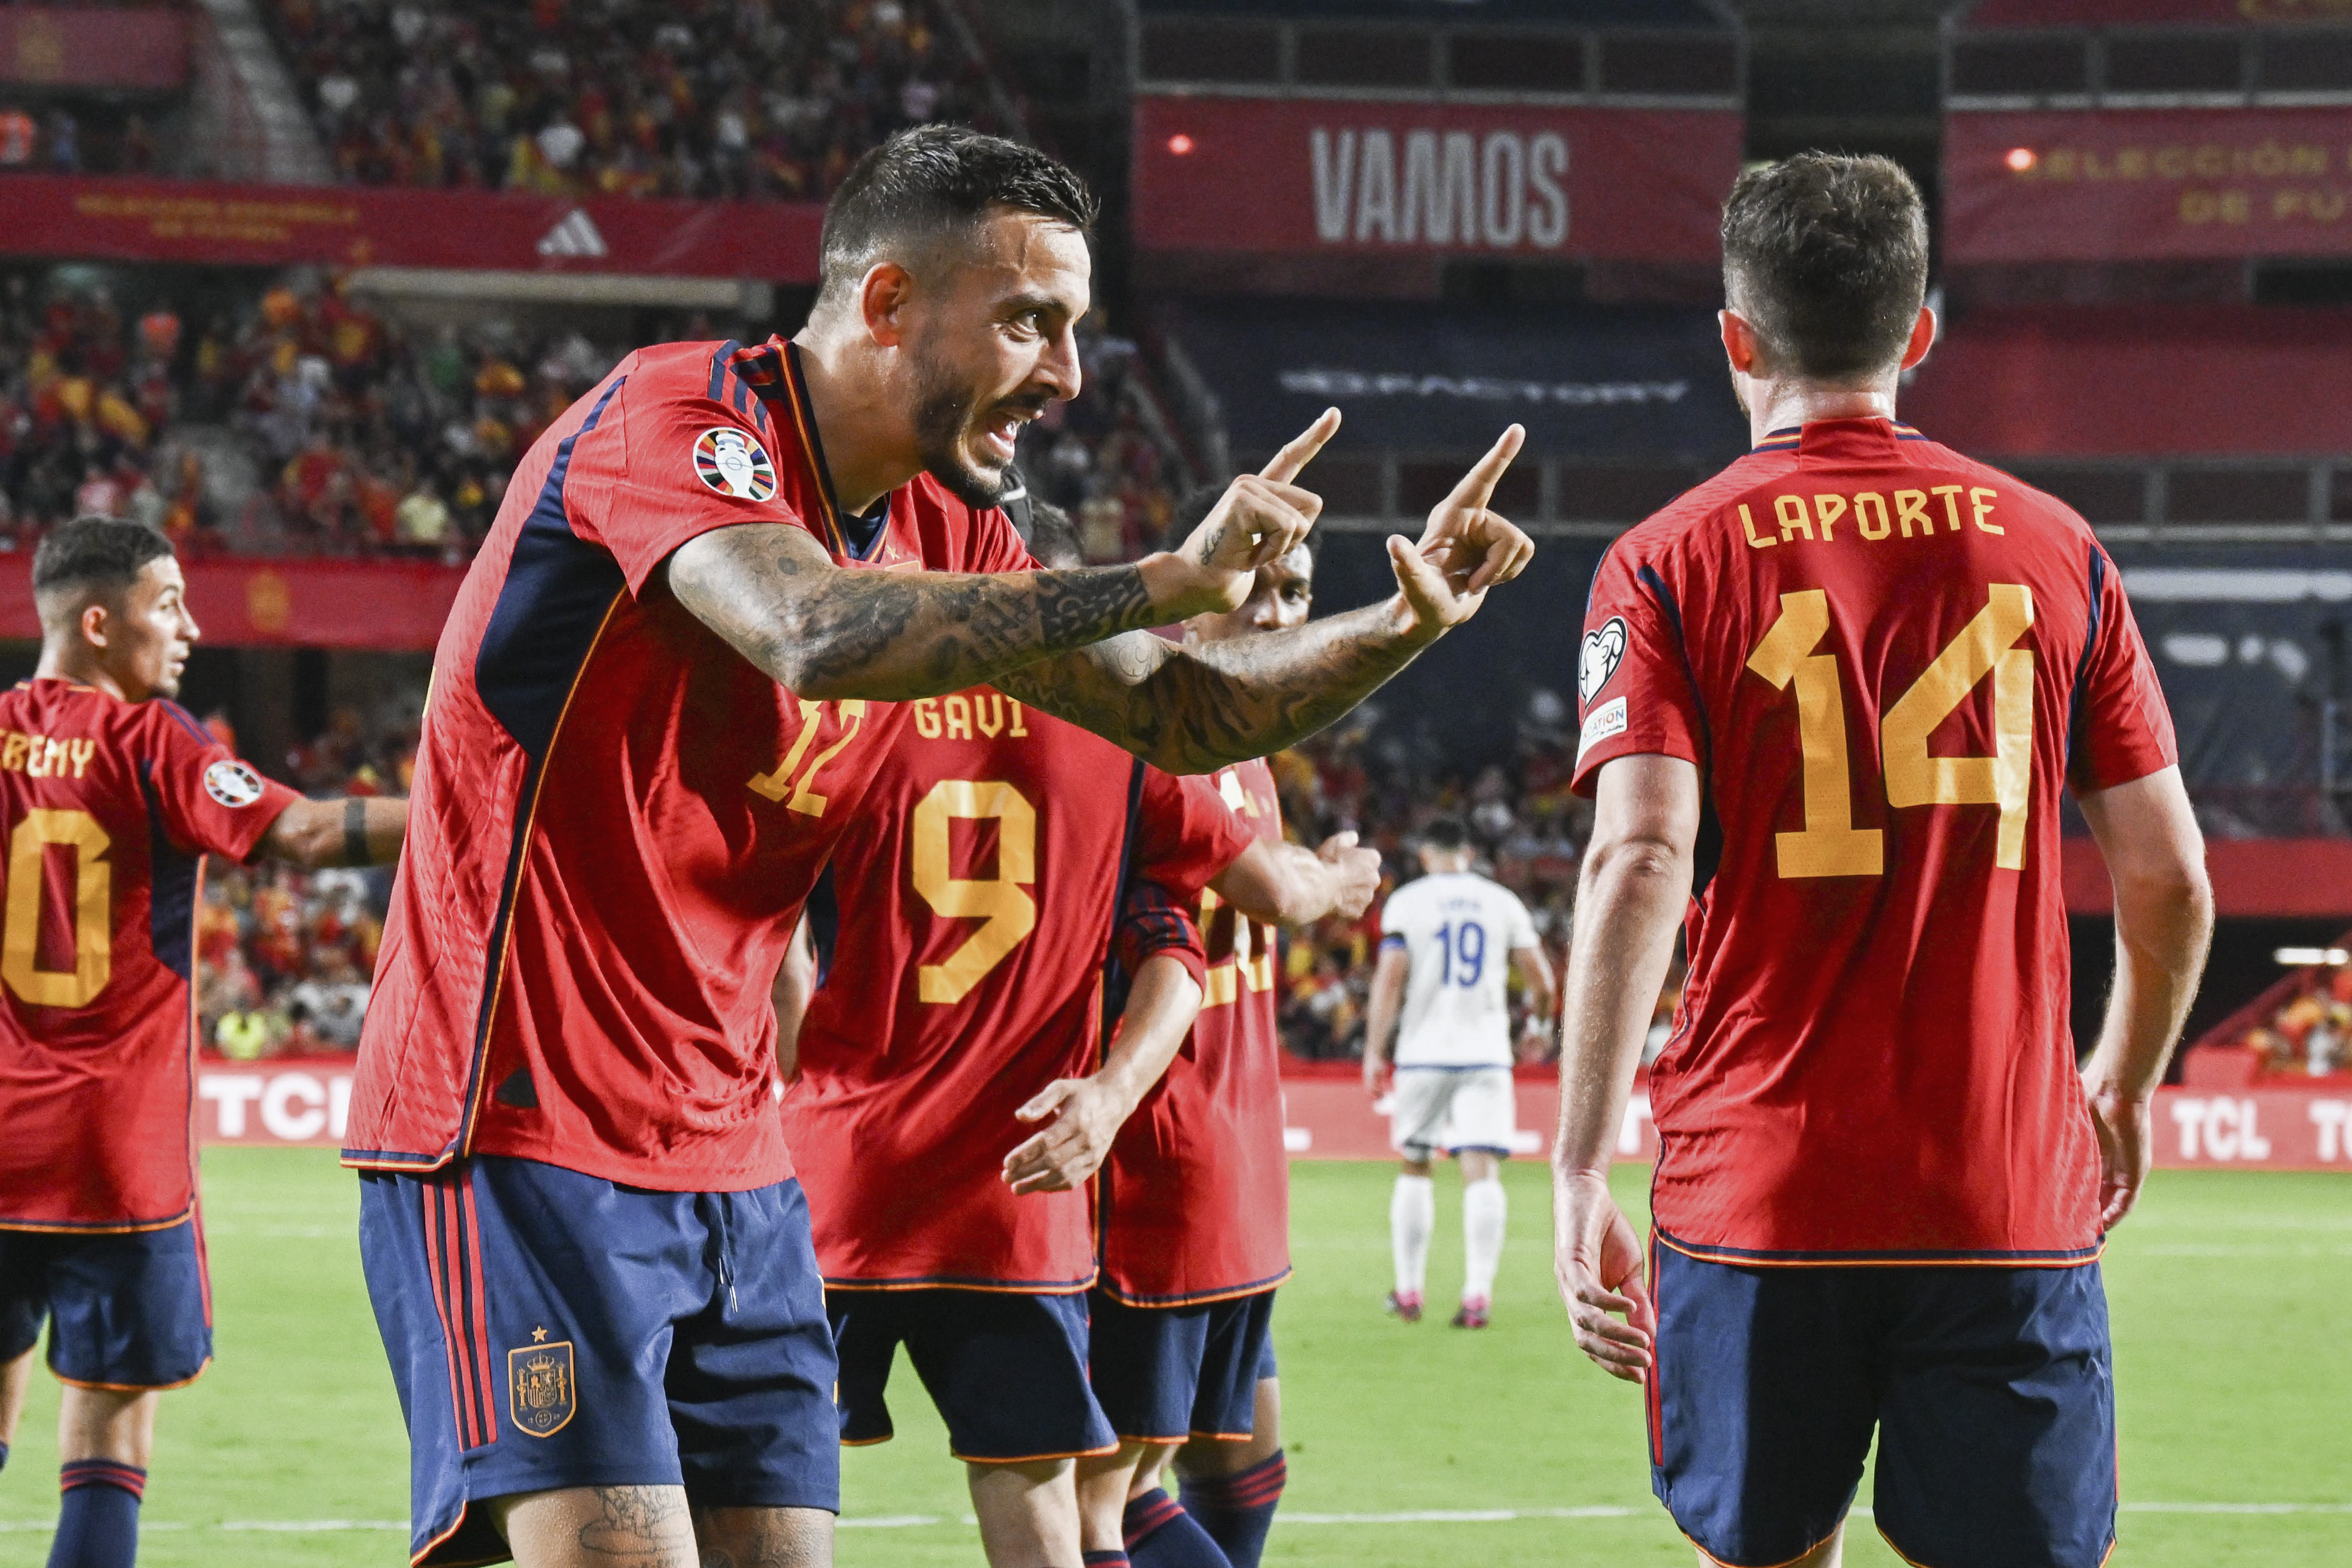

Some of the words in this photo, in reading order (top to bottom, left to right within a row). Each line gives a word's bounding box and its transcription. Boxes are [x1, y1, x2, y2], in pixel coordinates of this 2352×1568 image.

[1308, 128, 1569, 248] VAMOS
[1738, 485, 2005, 548] LAPORTE
[914, 695, 1028, 740] GAVI
[1746, 583, 2035, 878] 14
[912, 779, 1036, 1004] 9
[1434, 921, 1487, 989] 19
[2171, 1097, 2269, 1160] TCL
